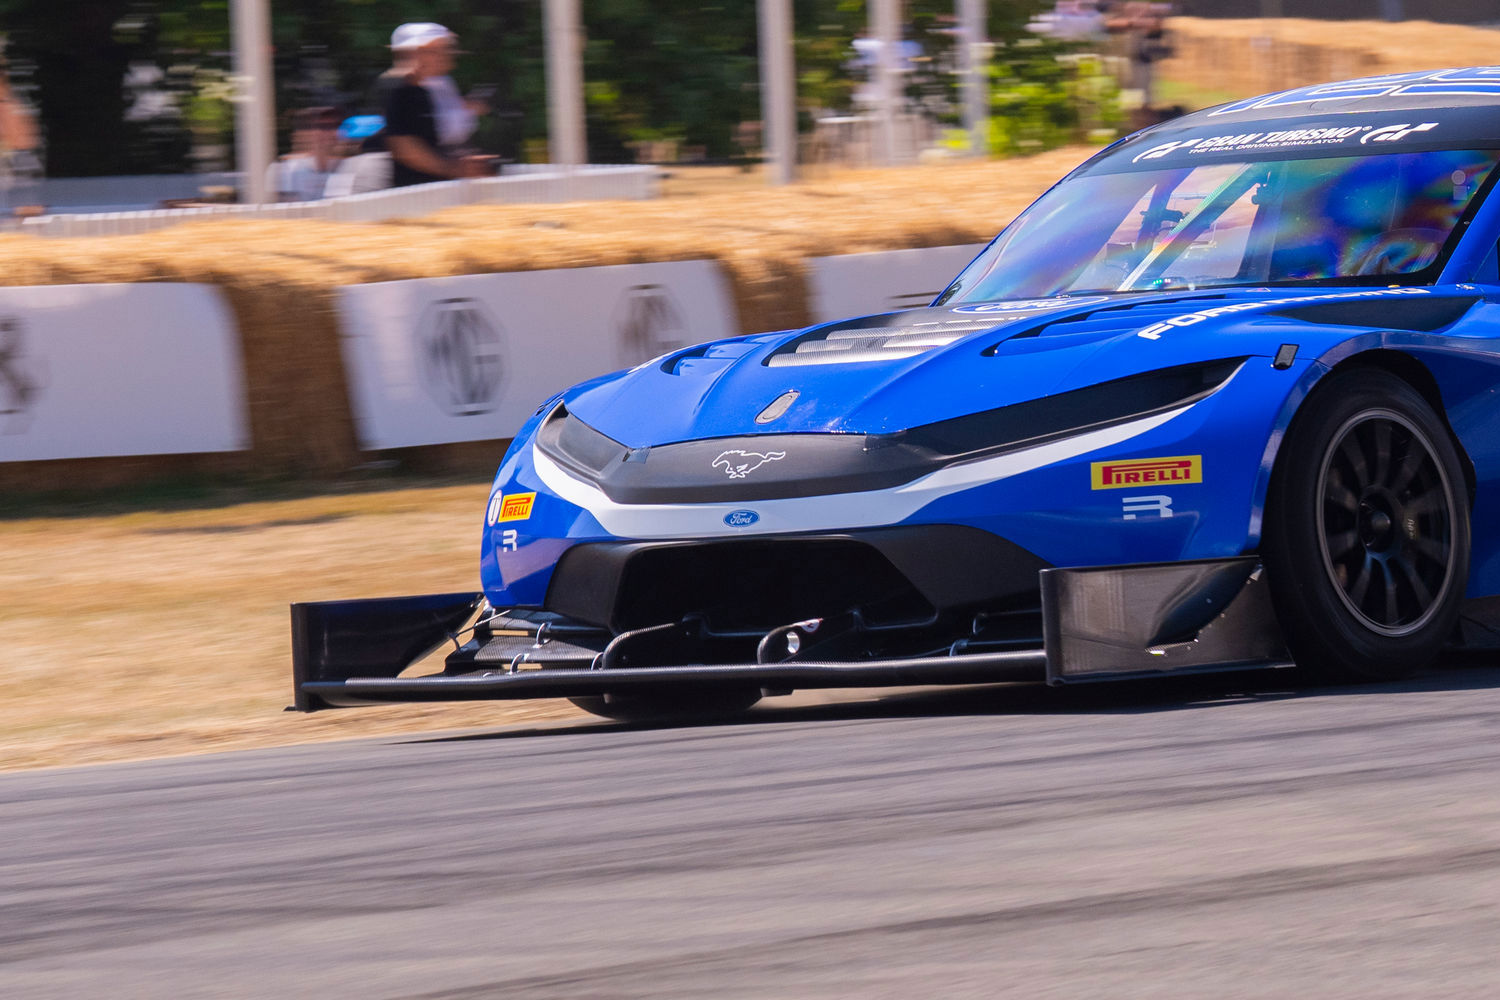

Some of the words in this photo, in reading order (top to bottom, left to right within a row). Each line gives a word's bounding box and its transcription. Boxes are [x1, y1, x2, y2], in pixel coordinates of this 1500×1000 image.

[1194, 132, 1264, 149] GRAN
[1236, 142, 1279, 150] DRIVING
[1280, 138, 1344, 147] SIMULATOR
[1137, 302, 1267, 341] FORD
[1102, 460, 1192, 486] PIRELLI
[502, 497, 532, 518] PIRELLI
